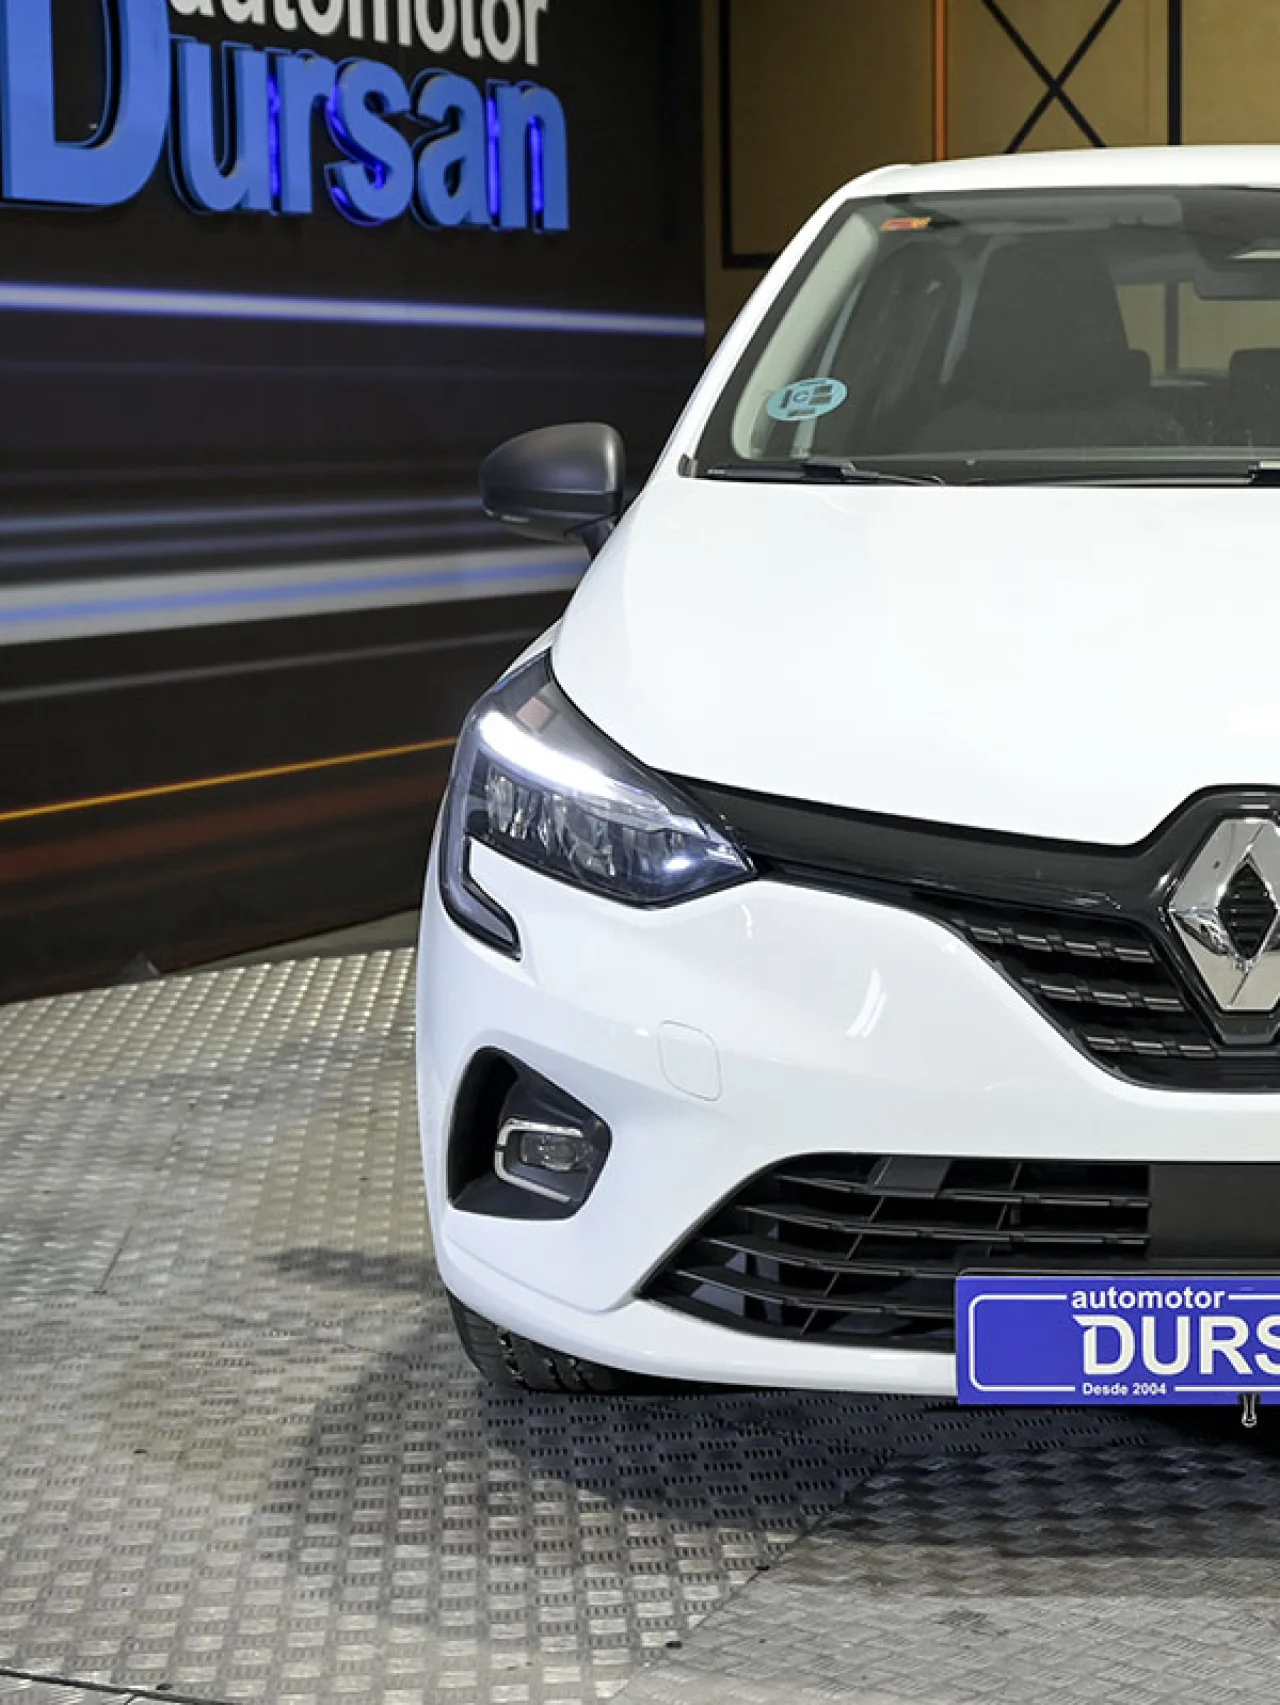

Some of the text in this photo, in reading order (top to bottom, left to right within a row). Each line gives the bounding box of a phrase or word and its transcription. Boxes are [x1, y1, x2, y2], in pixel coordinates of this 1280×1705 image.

[2, 0, 570, 231] Dursan
[1071, 1286, 1226, 1309] automotor
[1082, 1382, 1168, 1396] Desde 2004
